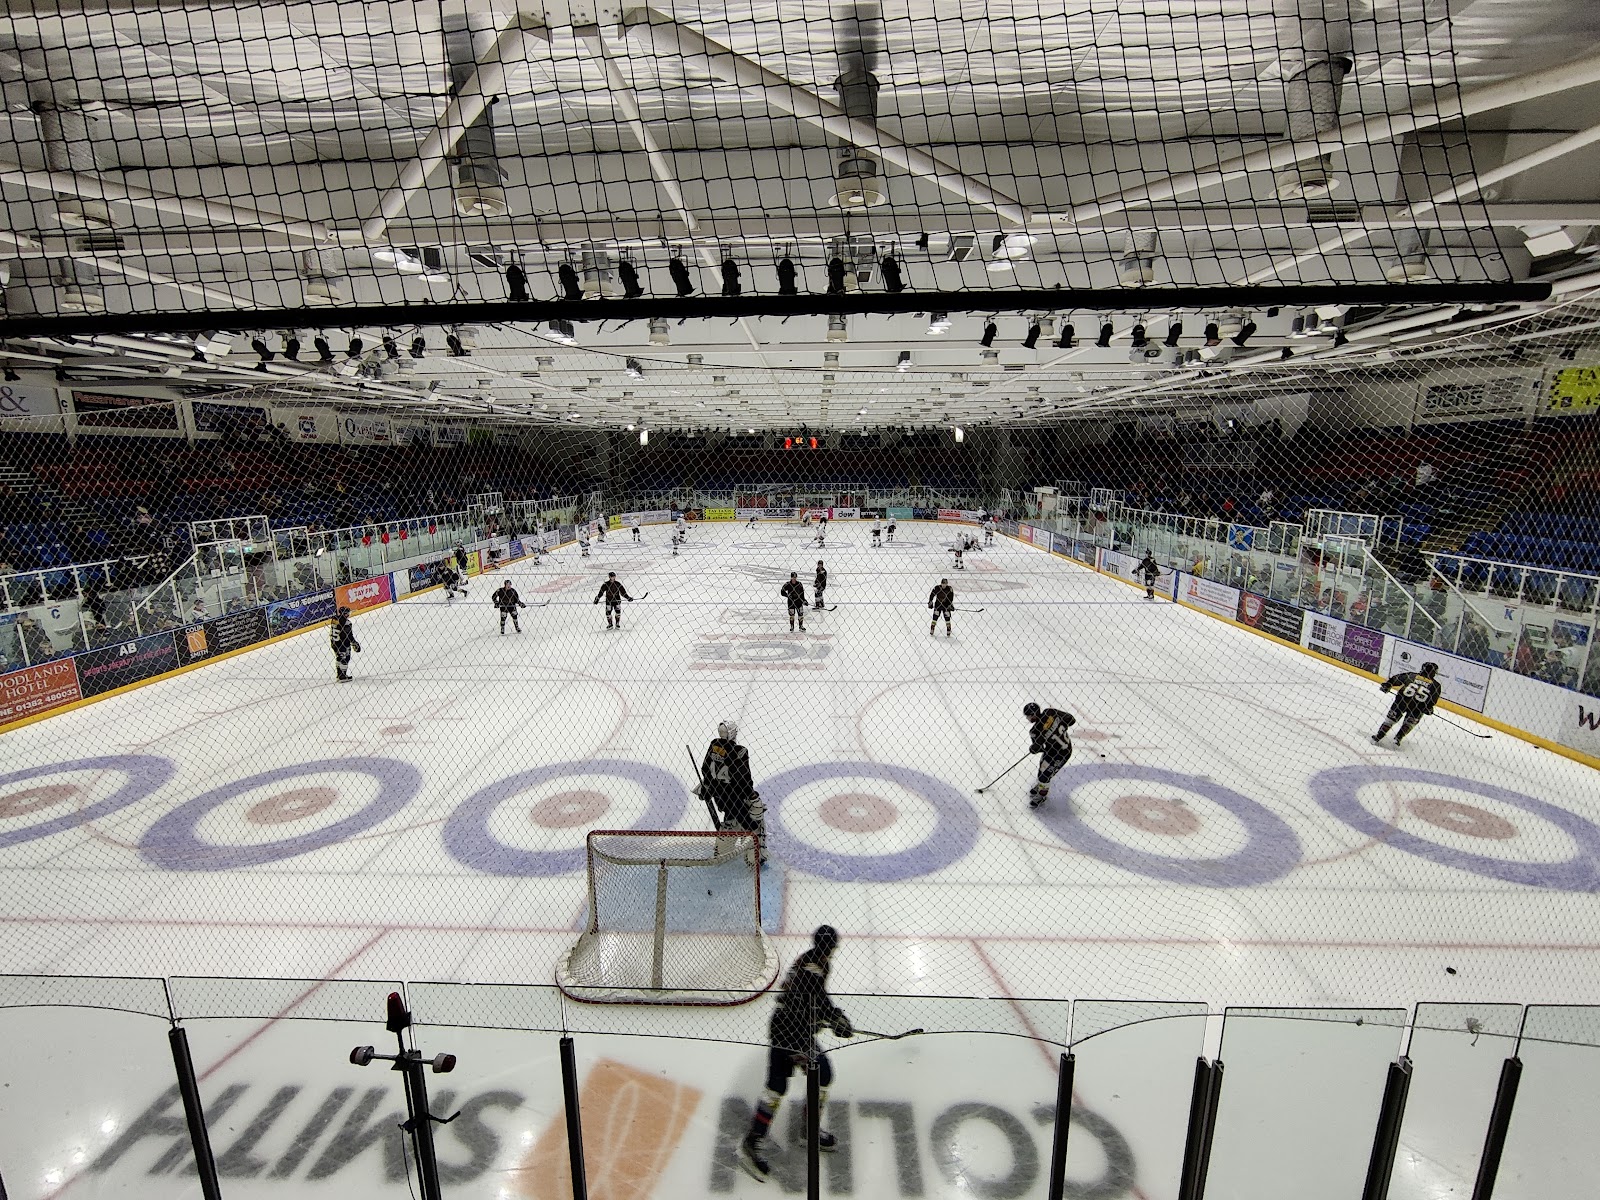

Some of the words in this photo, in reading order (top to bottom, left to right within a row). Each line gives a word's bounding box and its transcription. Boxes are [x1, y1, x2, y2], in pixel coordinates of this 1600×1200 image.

[185, 624, 204, 634] COLIN
[119, 643, 138, 656] AB
[190, 648, 209, 659] SMITH
[0, 663, 70, 690] ODLANDS
[6, 680, 51, 699] HOTEL
[15, 698, 43, 712] 01382
[45, 688, 78, 703] 480033
[1403, 682, 1431, 703] 65
[85, 1082, 528, 1186] SMITH
[708, 1097, 1136, 1200] COLIN
